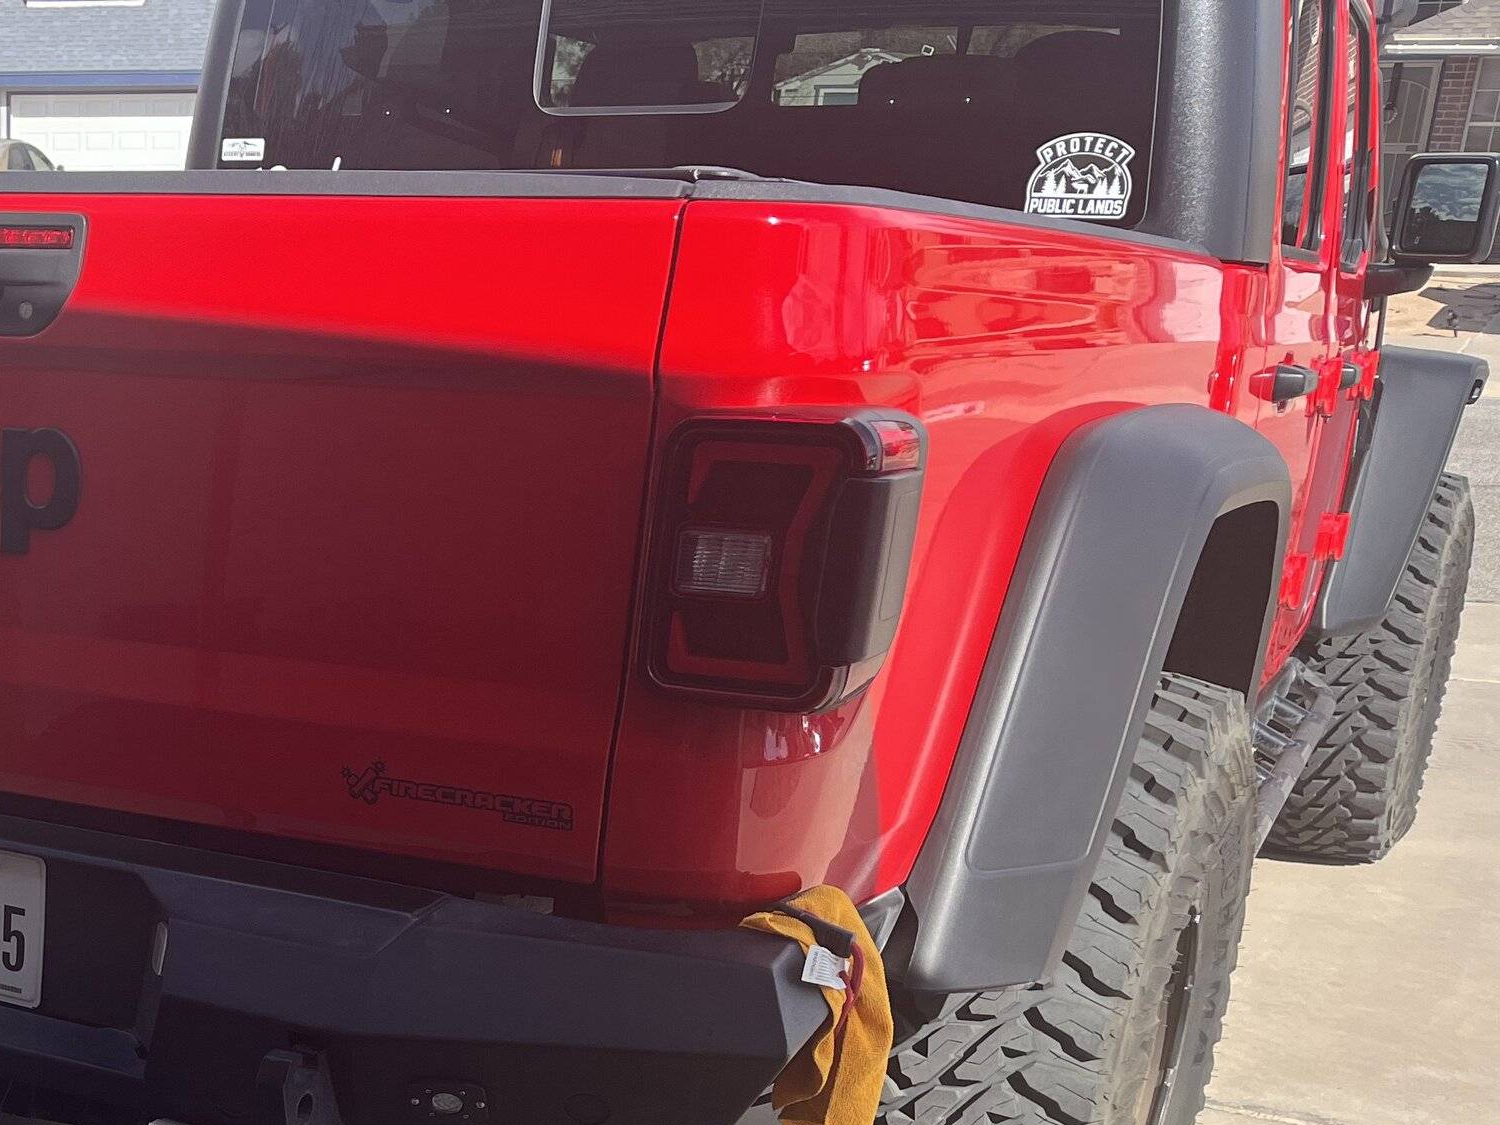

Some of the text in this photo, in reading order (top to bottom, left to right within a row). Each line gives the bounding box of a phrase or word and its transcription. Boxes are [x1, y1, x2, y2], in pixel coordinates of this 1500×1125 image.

[1042, 136, 1130, 163] PROTECT
[1029, 199, 1124, 215] PUBLIC LANDS
[372, 777, 573, 820] FIRECRACKER
